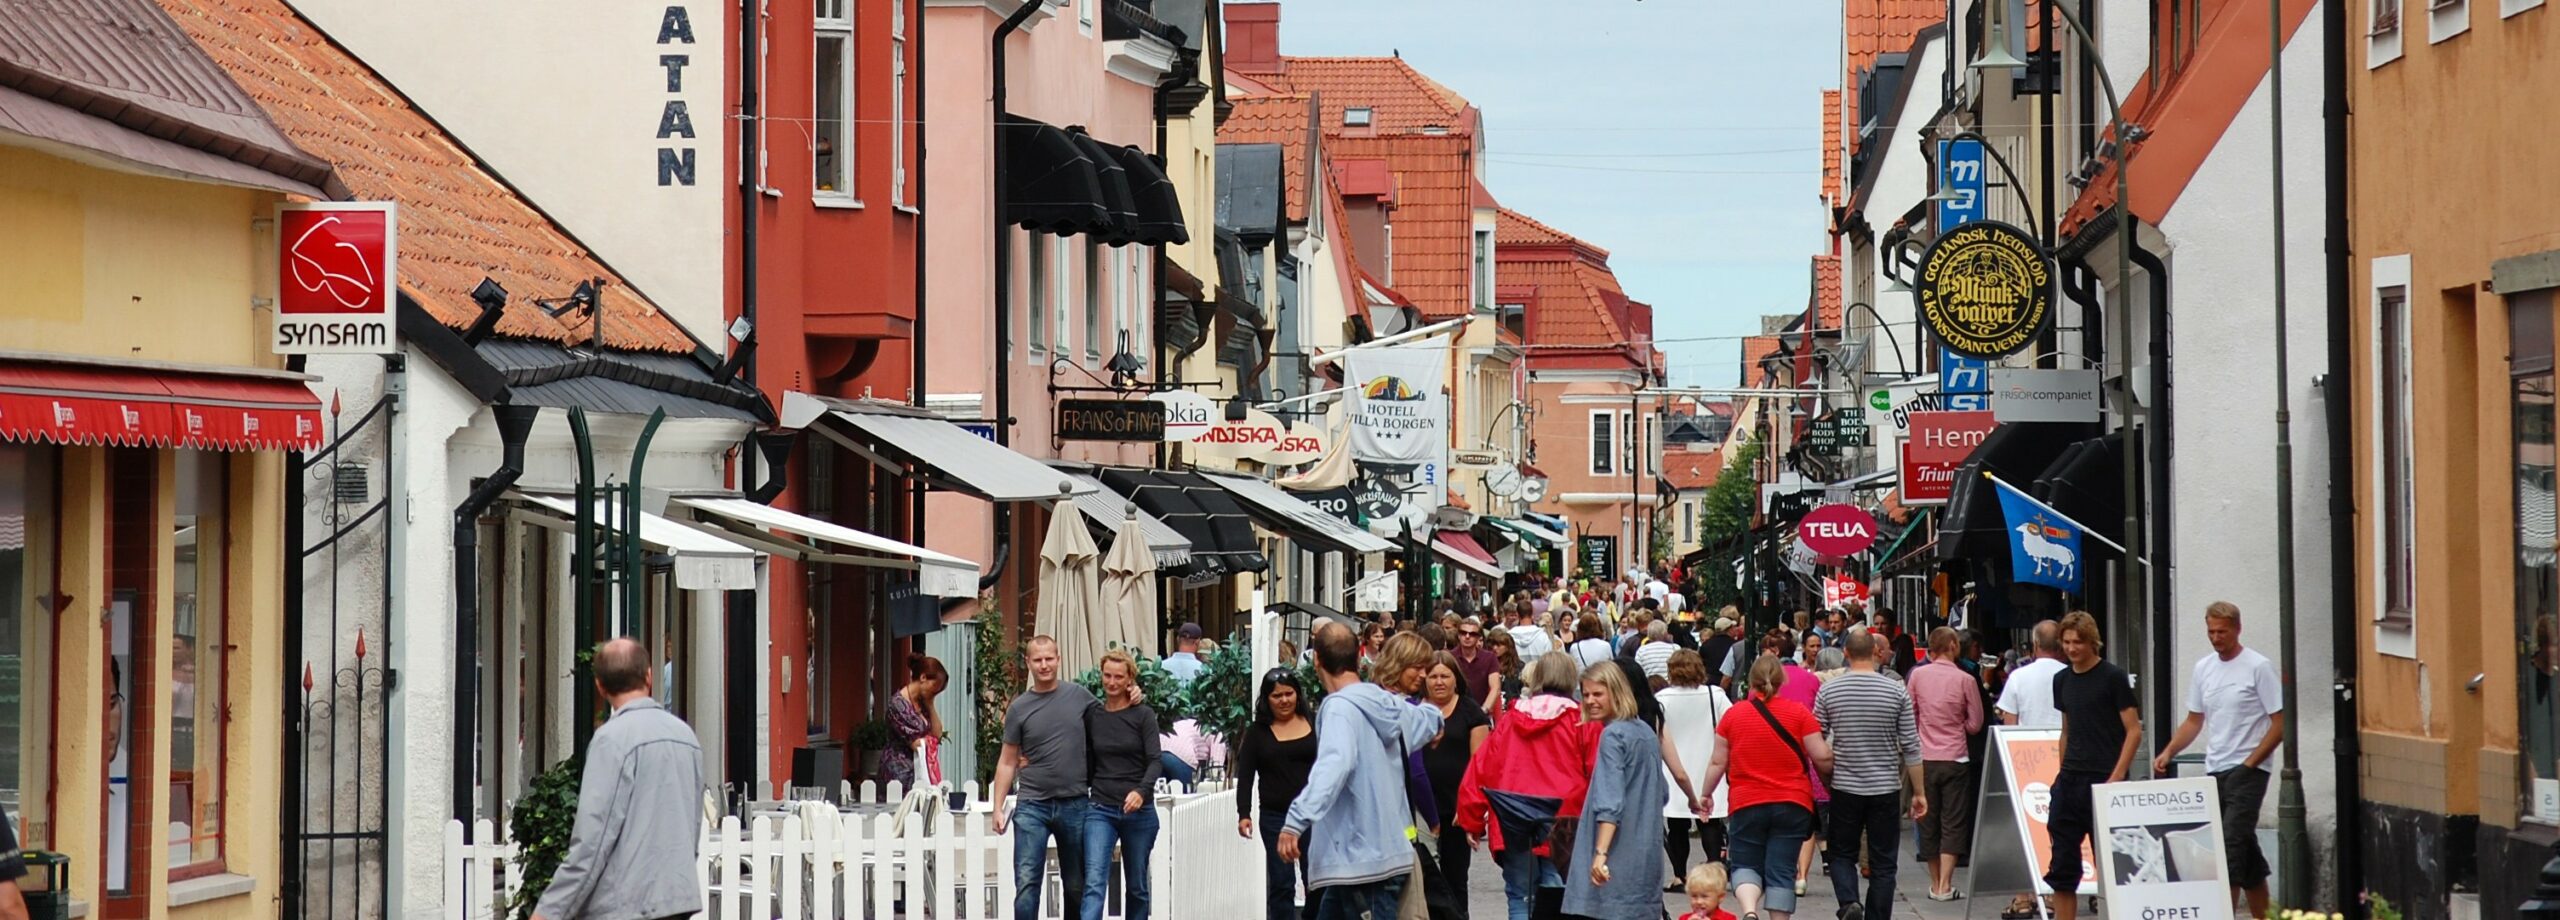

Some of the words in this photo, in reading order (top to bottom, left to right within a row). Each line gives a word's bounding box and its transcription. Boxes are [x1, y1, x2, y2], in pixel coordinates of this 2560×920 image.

[656, 6, 696, 186] ATAN
[278, 322, 385, 345] SYNSAM
[1367, 403, 1416, 417] HOTELL
[1383, 417, 1435, 430] BORGEN
[1811, 429, 1836, 437] BODY
[1811, 437, 1836, 445] SHOP
[1805, 521, 1870, 538] TELIA
[2110, 791, 2191, 809] ATTERDAG
[2195, 791, 2204, 804] 5
[2142, 906, 2201, 920] ÖPPET
